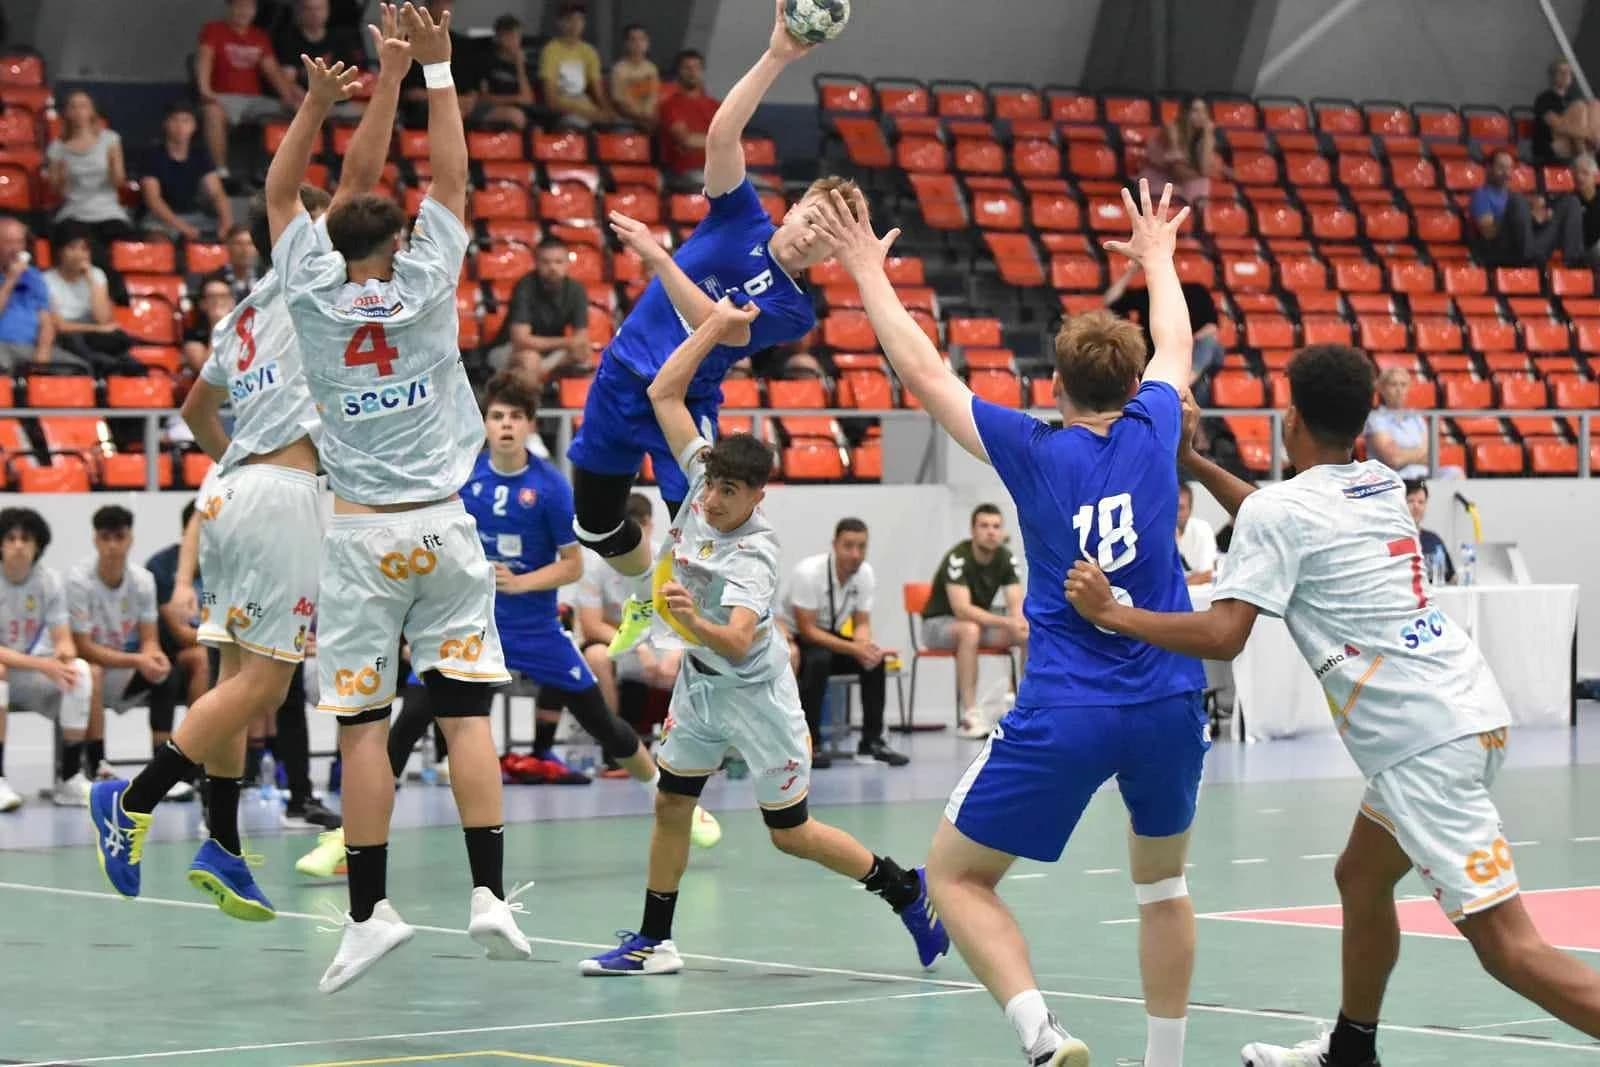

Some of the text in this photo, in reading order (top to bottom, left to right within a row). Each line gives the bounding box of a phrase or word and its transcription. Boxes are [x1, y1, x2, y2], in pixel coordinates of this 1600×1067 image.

[743, 268, 774, 297] 6
[236, 306, 256, 372] 8
[344, 321, 399, 377] 4
[343, 375, 429, 416] sacyr
[492, 484, 509, 516] 2
[1072, 492, 1139, 573] 18
[380, 533, 443, 581] GO fit
[1386, 536, 1428, 609] 7
[246, 602, 263, 618] fit
[335, 667, 381, 696] GO
